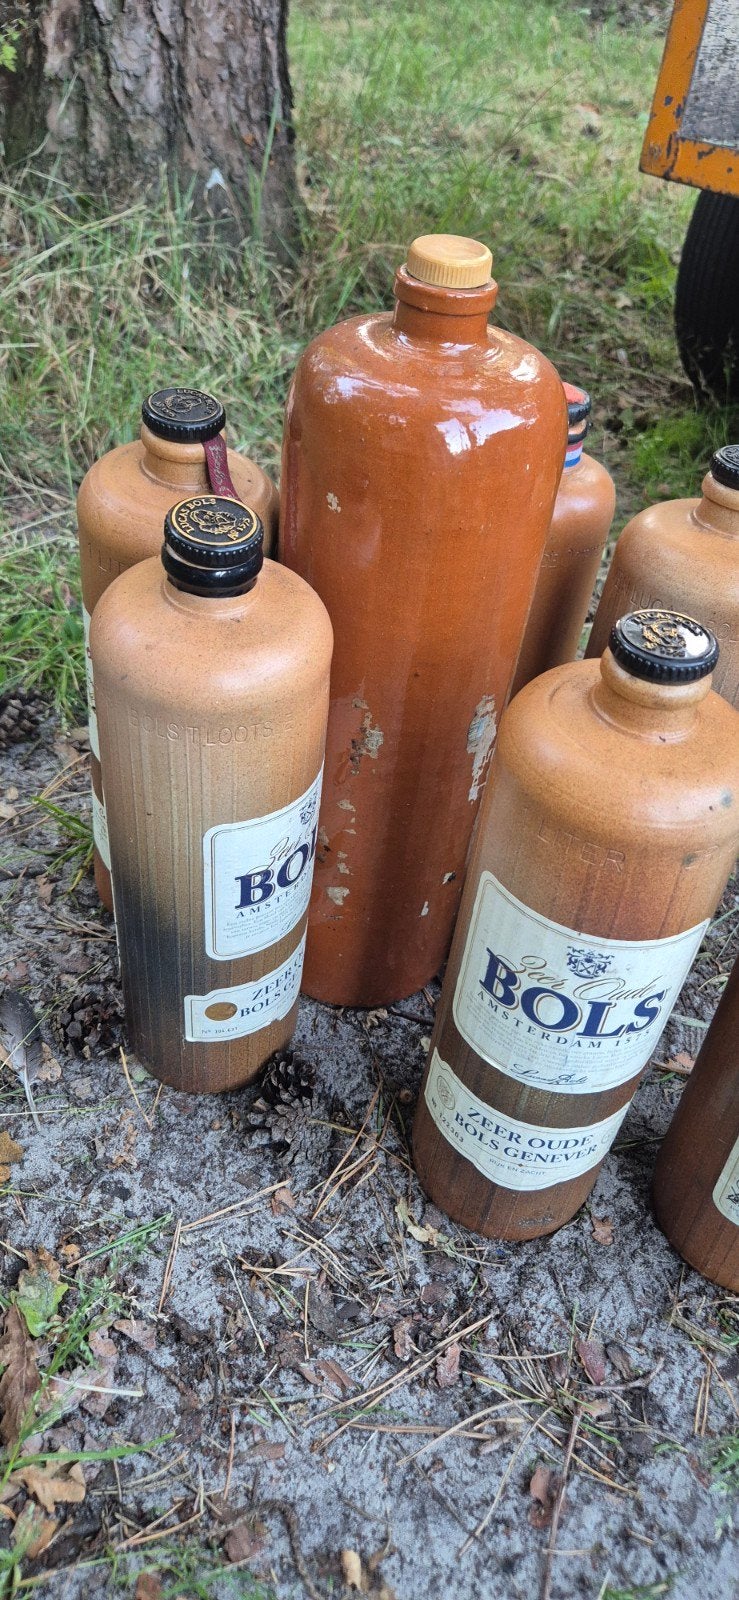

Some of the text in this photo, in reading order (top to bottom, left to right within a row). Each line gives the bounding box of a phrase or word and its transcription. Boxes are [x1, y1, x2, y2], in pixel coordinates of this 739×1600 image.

[178, 498, 217, 533] LUCAS BOLS
[537, 818, 626, 873] LITER
[251, 966, 292, 1001] ZEER
[479, 947, 671, 1038] BOLS
[495, 954, 569, 990] Zeer
[239, 989, 281, 1018] BOLS
[477, 991, 602, 1049] AMSTERDAM
[455, 1111, 598, 1164] BOLS GENEVER
[467, 1108, 594, 1150] ZEER OUDE
